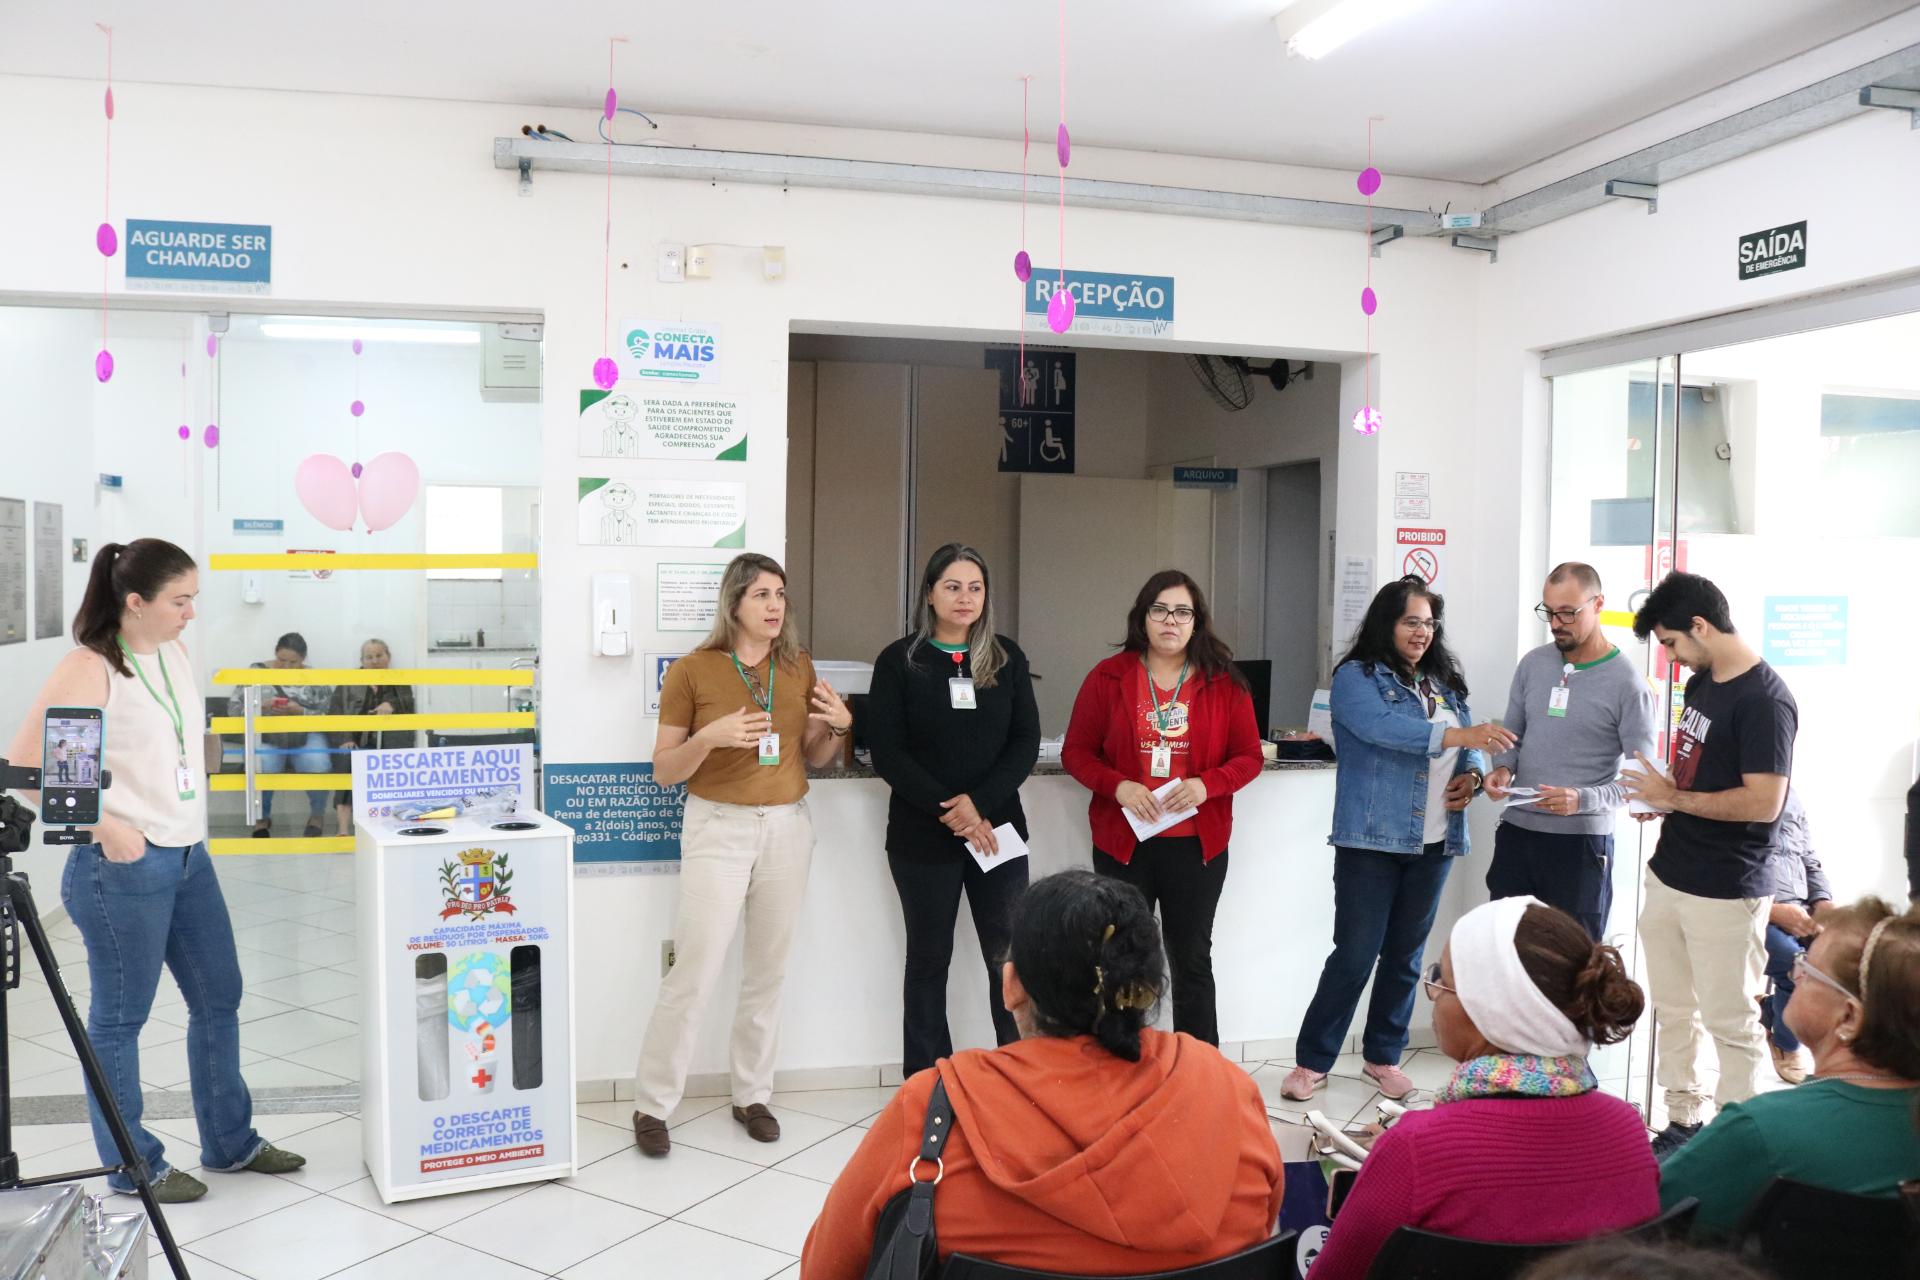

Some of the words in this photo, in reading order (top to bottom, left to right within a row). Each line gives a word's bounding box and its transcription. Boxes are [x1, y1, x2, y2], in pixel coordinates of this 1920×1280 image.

[131, 230, 227, 249] AGUARDE
[231, 235, 266, 251] SER
[1740, 230, 1804, 264] SAÍDA
[146, 250, 251, 269] CHAMADO
[1745, 264, 1755, 274] DE
[1755, 254, 1797, 271] EMERGÊNCIA
[654, 332, 715, 344] CONECTA
[654, 342, 715, 362] MAIS
[691, 400, 736, 409] PREFERÊNCIA
[678, 408, 715, 416] PACIENTES
[645, 415, 682, 423] ESTIVEREM
[695, 417, 723, 425] ESTADO
[1011, 418, 1028, 429] 60+
[648, 422, 671, 431] SAÚDE
[673, 424, 731, 433] COMPROMETIDO
[655, 432, 708, 441] AGRADECEMOS
[1183, 469, 1225, 481] ARQUIVO
[1399, 531, 1444, 542] PROIBIDO
[1141, 741, 1157, 749] USE
[367, 751, 465, 771] DESCARTE
[471, 749, 520, 768] AQUI
[367, 766, 521, 789] MEDICAMENTOS
[550, 774, 617, 785] DESACATAR
[372, 791, 425, 800] DOMICILIARES
[426, 788, 463, 797] VENCIDOS
[576, 786, 595, 796] NO
[598, 783, 658, 796] EXERCÍCIO
[661, 785, 678, 794] DA
[566, 798, 584, 808] OU
[588, 798, 606, 807] EM
[610, 795, 650, 807] RAZÃO
[554, 809, 582, 819] Pena
[585, 809, 600, 819] de
[603, 808, 656, 820] detenção
[659, 808, 673, 817] de
[595, 820, 634, 832] 2(dois)
[637, 821, 668, 830] anos,
[622, 832, 661, 843] Código
[423, 932, 465, 943] RESÍDUOS
[487, 926, 547, 938] DISPENSADOR:
[433, 924, 487, 935] CAPACIDADE
[488, 921, 522, 931] MÁXIMA
[406, 941, 444, 951] VOLUME:
[459, 938, 488, 947] LITROS
[495, 935, 527, 943] MASSA:
[433, 1117, 446, 1128] O
[450, 1106, 531, 1126] DESCARTE
[433, 1122, 506, 1141] CORRETO
[511, 1118, 531, 1130] DE
[420, 1129, 543, 1156] MEDICAMENTOS
[423, 1158, 465, 1170] PROTEGE
[466, 1156, 474, 1164] O
[475, 1154, 497, 1163] MEIO
[498, 1147, 542, 1160] AMBIENTE
